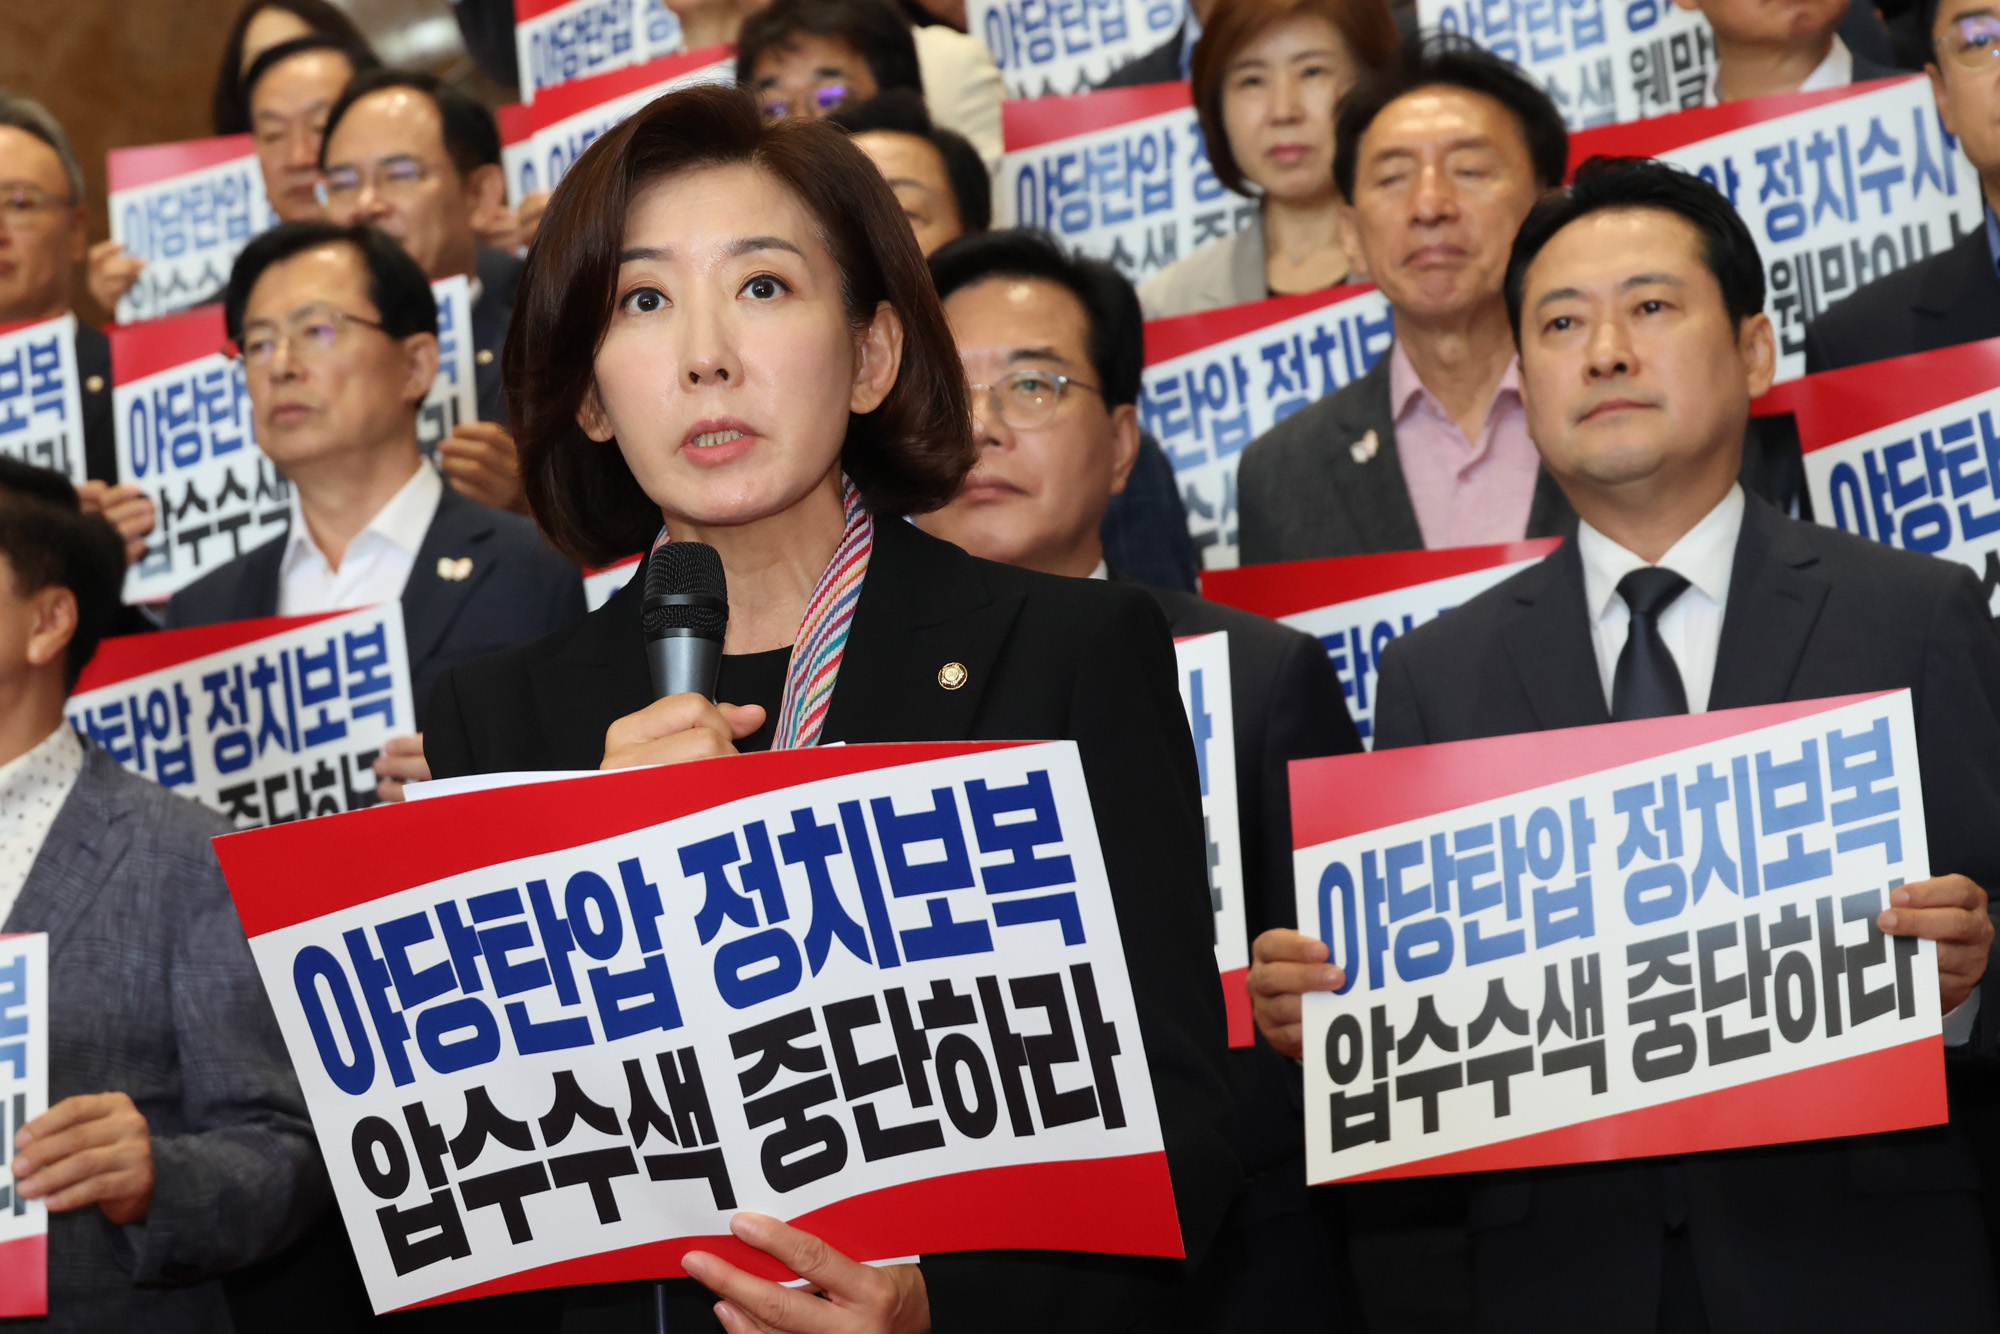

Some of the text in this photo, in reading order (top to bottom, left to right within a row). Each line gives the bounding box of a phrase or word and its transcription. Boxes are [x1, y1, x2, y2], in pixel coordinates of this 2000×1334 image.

[1017, 126, 1176, 235] 야당탄압
[1754, 105, 1958, 243] 정치수사
[201, 622, 395, 776] 정치보복
[293, 858, 684, 1096] 야당탄압
[678, 769, 1087, 1010] 정치보복
[1317, 796, 1597, 996] 야당탄압
[1612, 716, 1904, 926] 정치보복
[351, 962, 1127, 1277] 압수수색 중단하라
[1324, 877, 1919, 1154] 압수수색 중단하라
